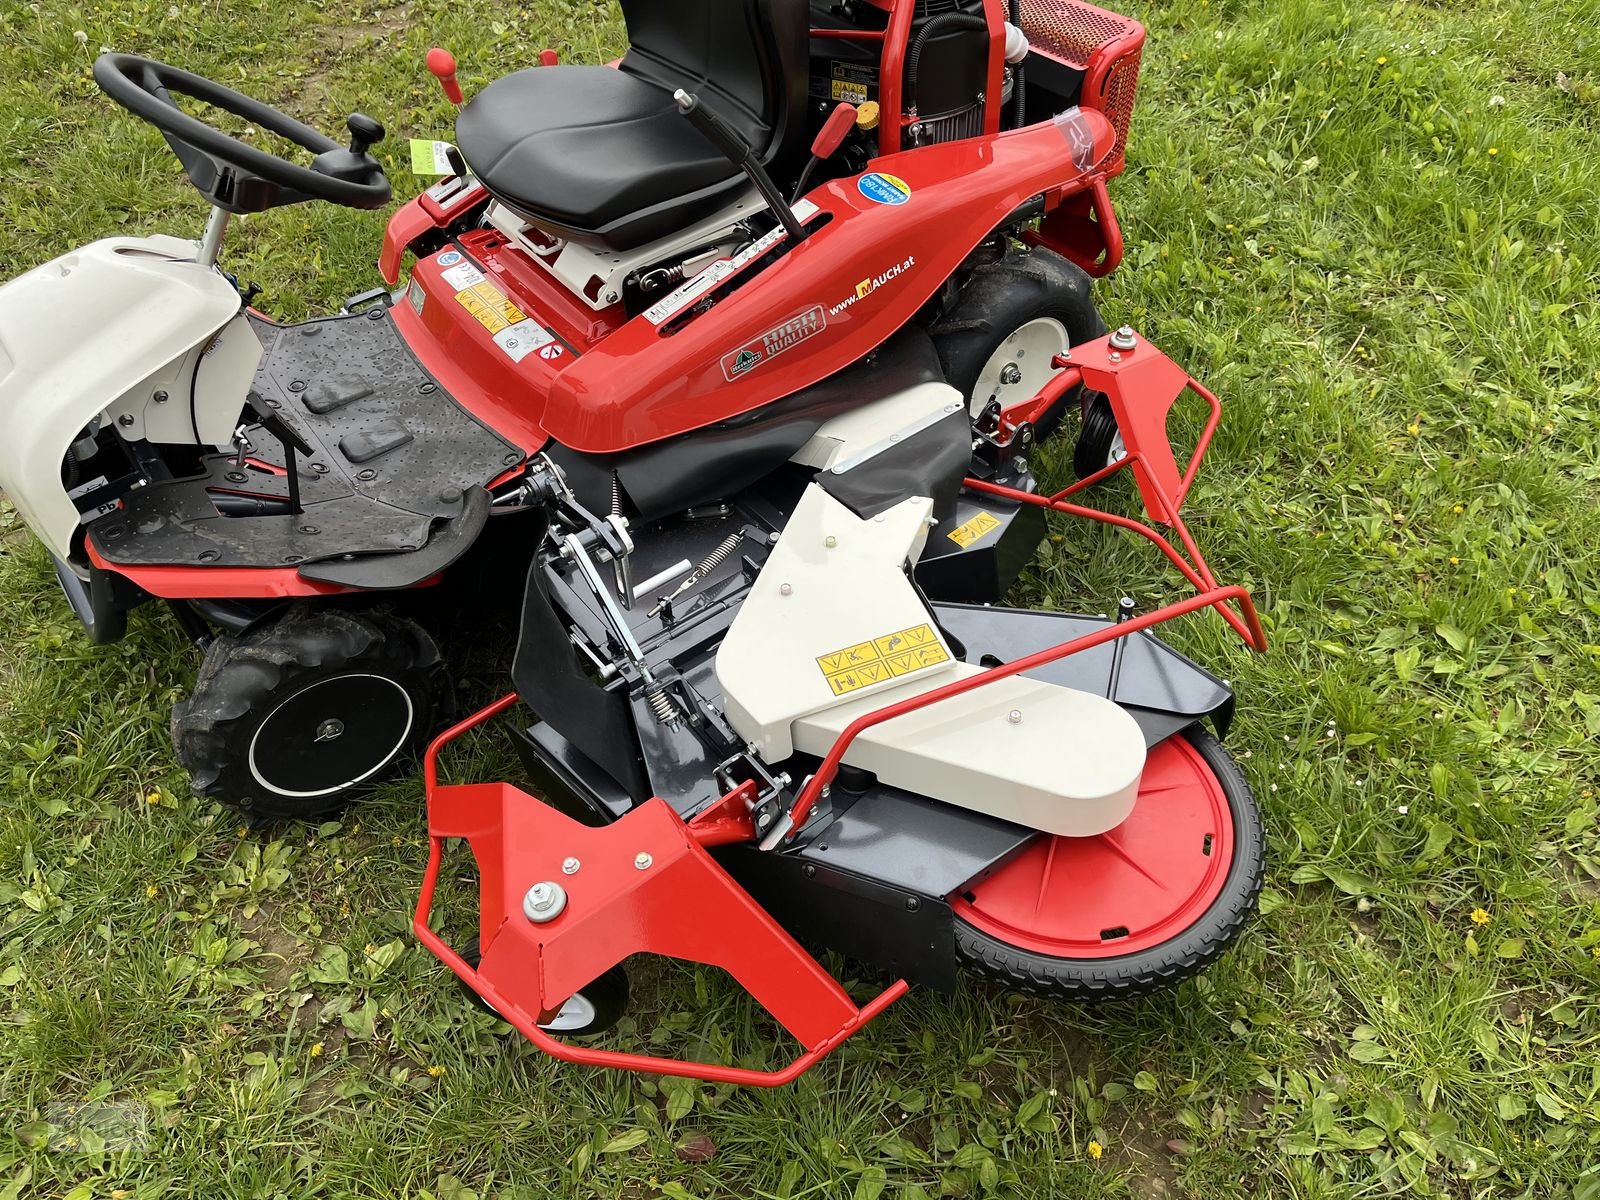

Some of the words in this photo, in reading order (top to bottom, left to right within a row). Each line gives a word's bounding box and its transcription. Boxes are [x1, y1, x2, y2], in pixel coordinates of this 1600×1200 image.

[860, 178, 898, 203] RMK180
[829, 255, 916, 316] www.MAUCH.at
[762, 311, 817, 347] HIGH
[97, 503, 116, 515] Pb
